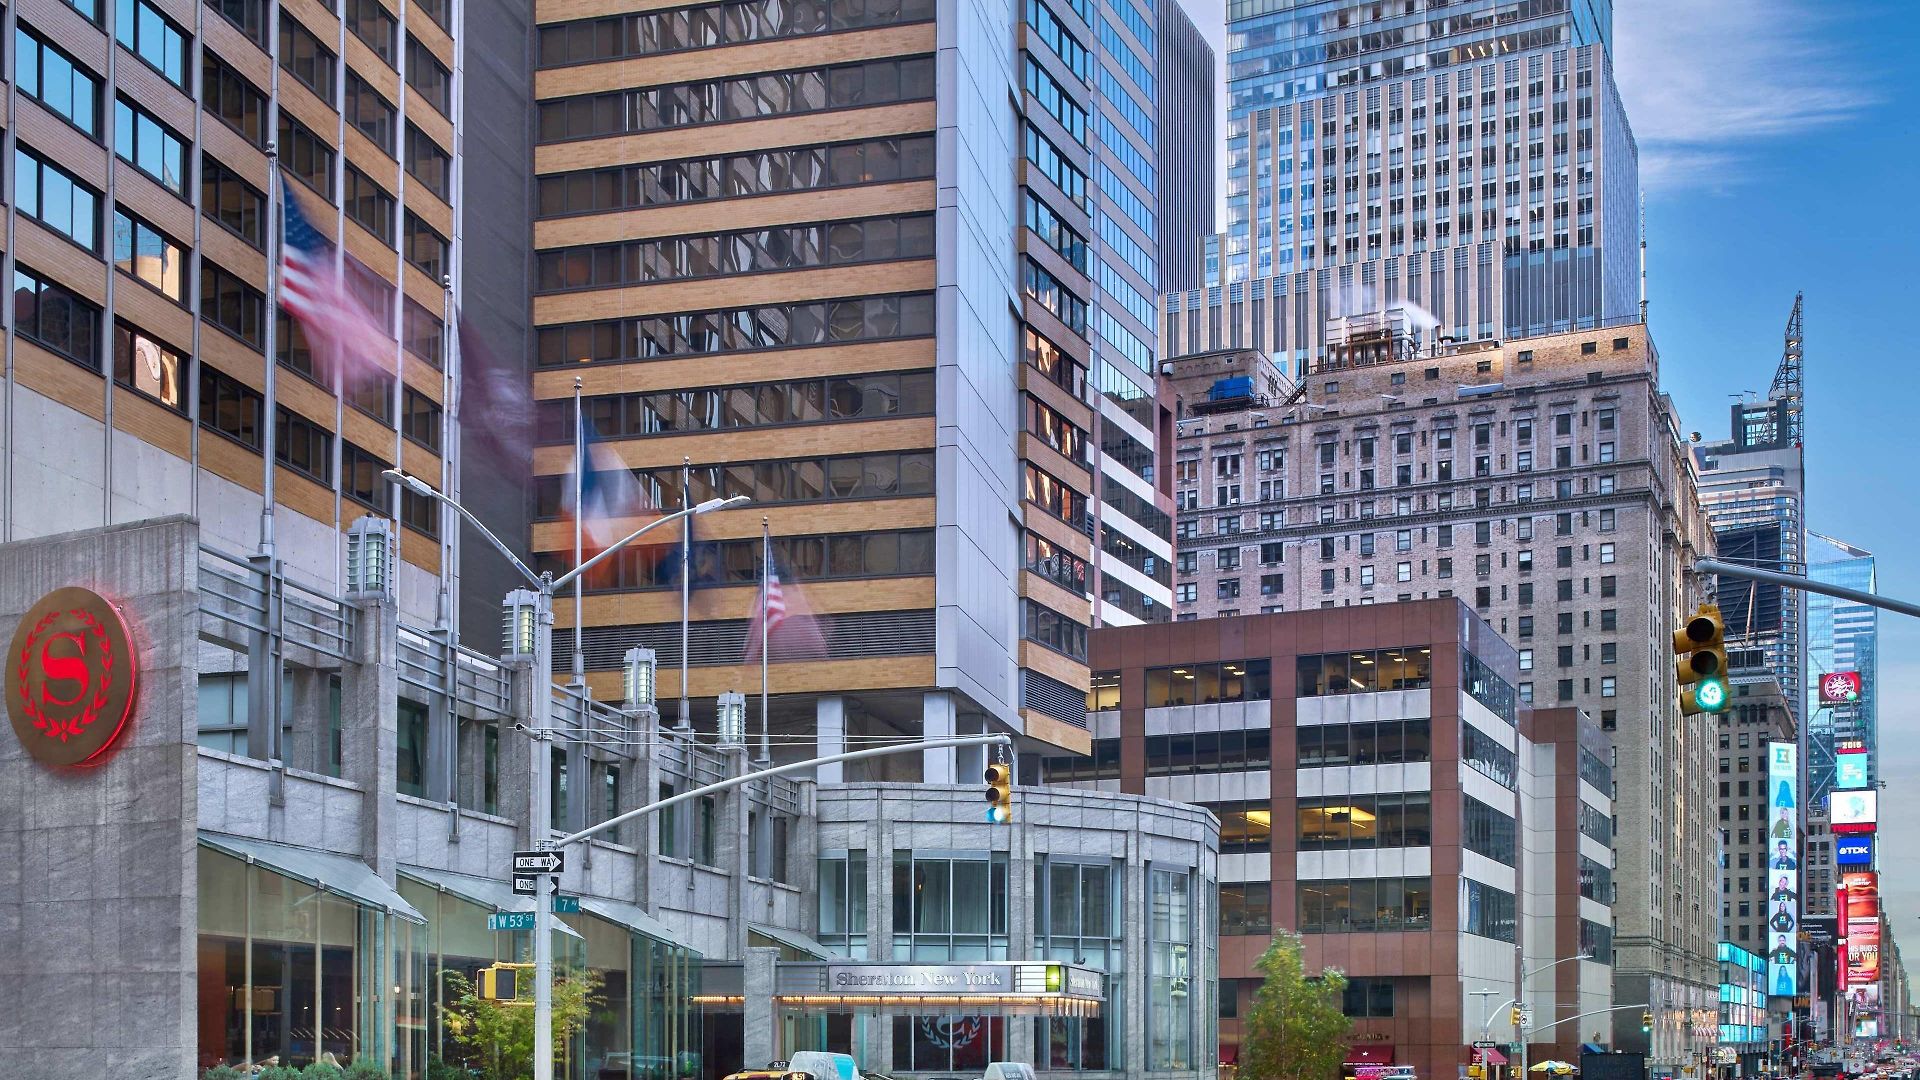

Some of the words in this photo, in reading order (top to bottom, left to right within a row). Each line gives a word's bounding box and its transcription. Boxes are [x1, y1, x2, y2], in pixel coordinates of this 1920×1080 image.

[41, 631, 90, 706] S
[1846, 846, 1869, 854] TDK
[519, 858, 535, 867] ONE
[540, 858, 557, 867] WAY
[519, 880, 534, 889] ONE
[562, 899, 568, 911] 7
[498, 915, 507, 928] W
[1848, 952, 1860, 961] OR
[1862, 952, 1878, 961] YOU
[836, 972, 915, 986] Sheraton
[921, 972, 957, 986] New
[963, 972, 1001, 986] York
